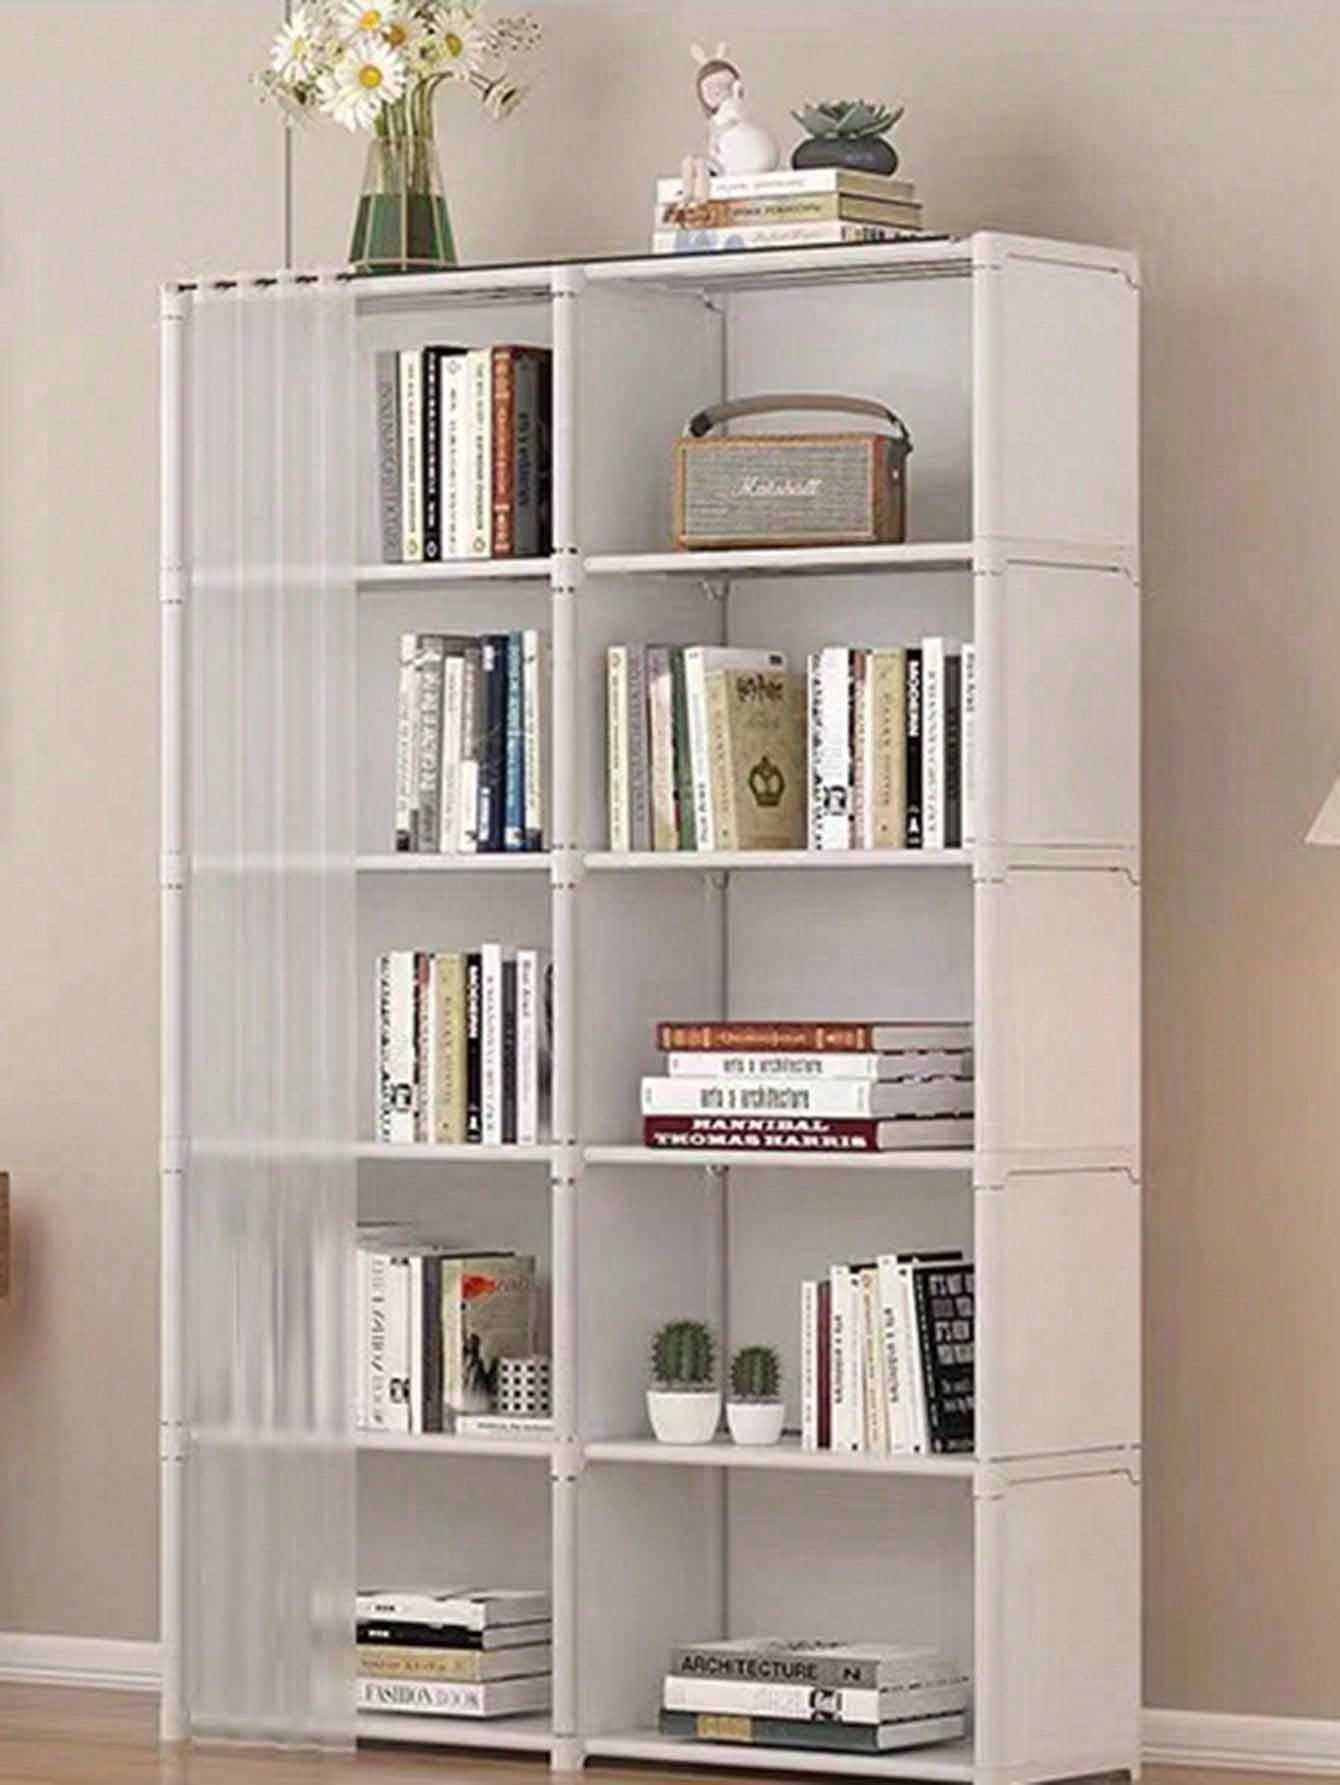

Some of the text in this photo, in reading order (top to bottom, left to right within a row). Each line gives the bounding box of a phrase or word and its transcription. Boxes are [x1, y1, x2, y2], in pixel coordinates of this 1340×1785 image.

[692, 1119, 830, 1132] HANNIBAL
[653, 1132, 868, 1149] THOMAS HARRIS
[681, 1655, 818, 1681] ARCHITECTURE
[364, 1682, 433, 1706] FASHION
